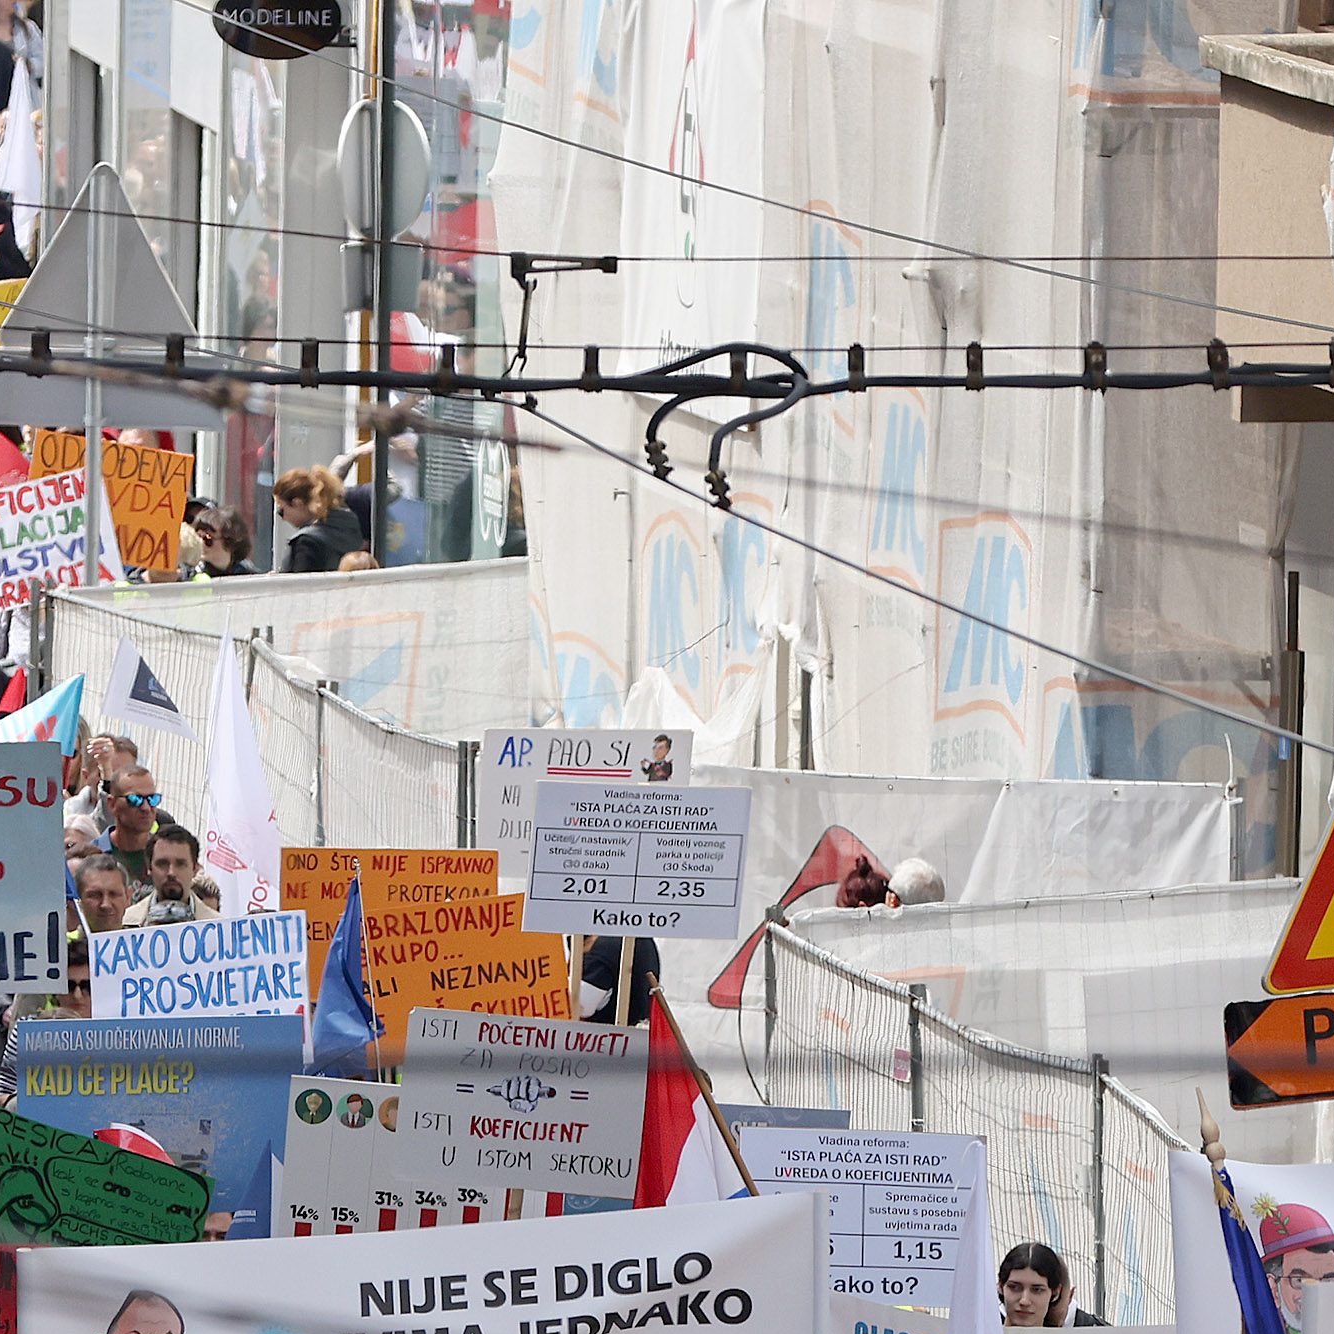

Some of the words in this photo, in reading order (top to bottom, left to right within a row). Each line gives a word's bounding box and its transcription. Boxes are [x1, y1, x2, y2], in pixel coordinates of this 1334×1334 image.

[221, 3, 333, 29] MODELINE
[547, 737, 592, 769] PAO
[643, 791, 683, 802] reforma:
[603, 801, 641, 815] PLAĆA
[643, 805, 659, 815] ZA
[563, 817, 611, 829] UVREDA
[625, 818, 719, 832] KOEFICIJENTIMA
[286, 855, 319, 873] ONO
[372, 855, 410, 878] NIJE
[421, 855, 495, 876] ISPRAVNO
[562, 877, 609, 896] 2,01
[657, 880, 706, 900] 2,35
[592, 908, 643, 928] Kako
[648, 910, 681, 929] to?
[95, 930, 171, 978] KAKO
[178, 913, 303, 966] OCIJENITI
[431, 955, 552, 992] NEZNANJE
[121, 964, 303, 1017] PROSVJETARE
[25, 1029, 86, 1053] NARASLA
[88, 1030, 105, 1052] SU
[106, 1026, 186, 1051] OČEKIVANJA
[195, 1027, 244, 1051] NORME,
[421, 1016, 459, 1042] ISTI
[478, 1019, 556, 1050] POČETNI
[565, 1029, 630, 1058] UVJETI
[26, 1063, 75, 1097] KAD
[79, 1057, 107, 1097] ĆE
[110, 1055, 195, 1095] PLAĆE?
[519, 1053, 591, 1078] POSAO
[413, 1110, 454, 1138] ISTI
[469, 1112, 590, 1144] KOEFICIJENT
[818, 1135, 860, 1147] Vladina
[862, 1138, 910, 1149] reforma:
[477, 1147, 532, 1172] ISTOM
[549, 1151, 634, 1180] SEKTORU
[819, 1149, 861, 1164] PLAĆA
[864, 1153, 881, 1164] ZA
[885, 1155, 910, 1166] ISTI
[774, 1167, 827, 1180] UVREDA
[831, 1168, 842, 1179] O
[845, 1168, 954, 1185] KOEFICIJENTIMA
[290, 1205, 319, 1222] 14%
[331, 1207, 359, 1224] 15%
[374, 1191, 404, 1208] 31%
[415, 1190, 447, 1208] 34%
[457, 1189, 489, 1206] 39%
[885, 1191, 948, 1206] Spremačice
[869, 1205, 910, 1216] sustavu
[885, 1220, 931, 1232] uvjetima
[933, 1221, 958, 1232] rada
[893, 1240, 943, 1261] 1,15
[359, 1273, 468, 1319] NIJE
[482, 1265, 539, 1309] SE
[555, 1250, 714, 1304] DIGLO
[881, 1276, 919, 1295] to?
